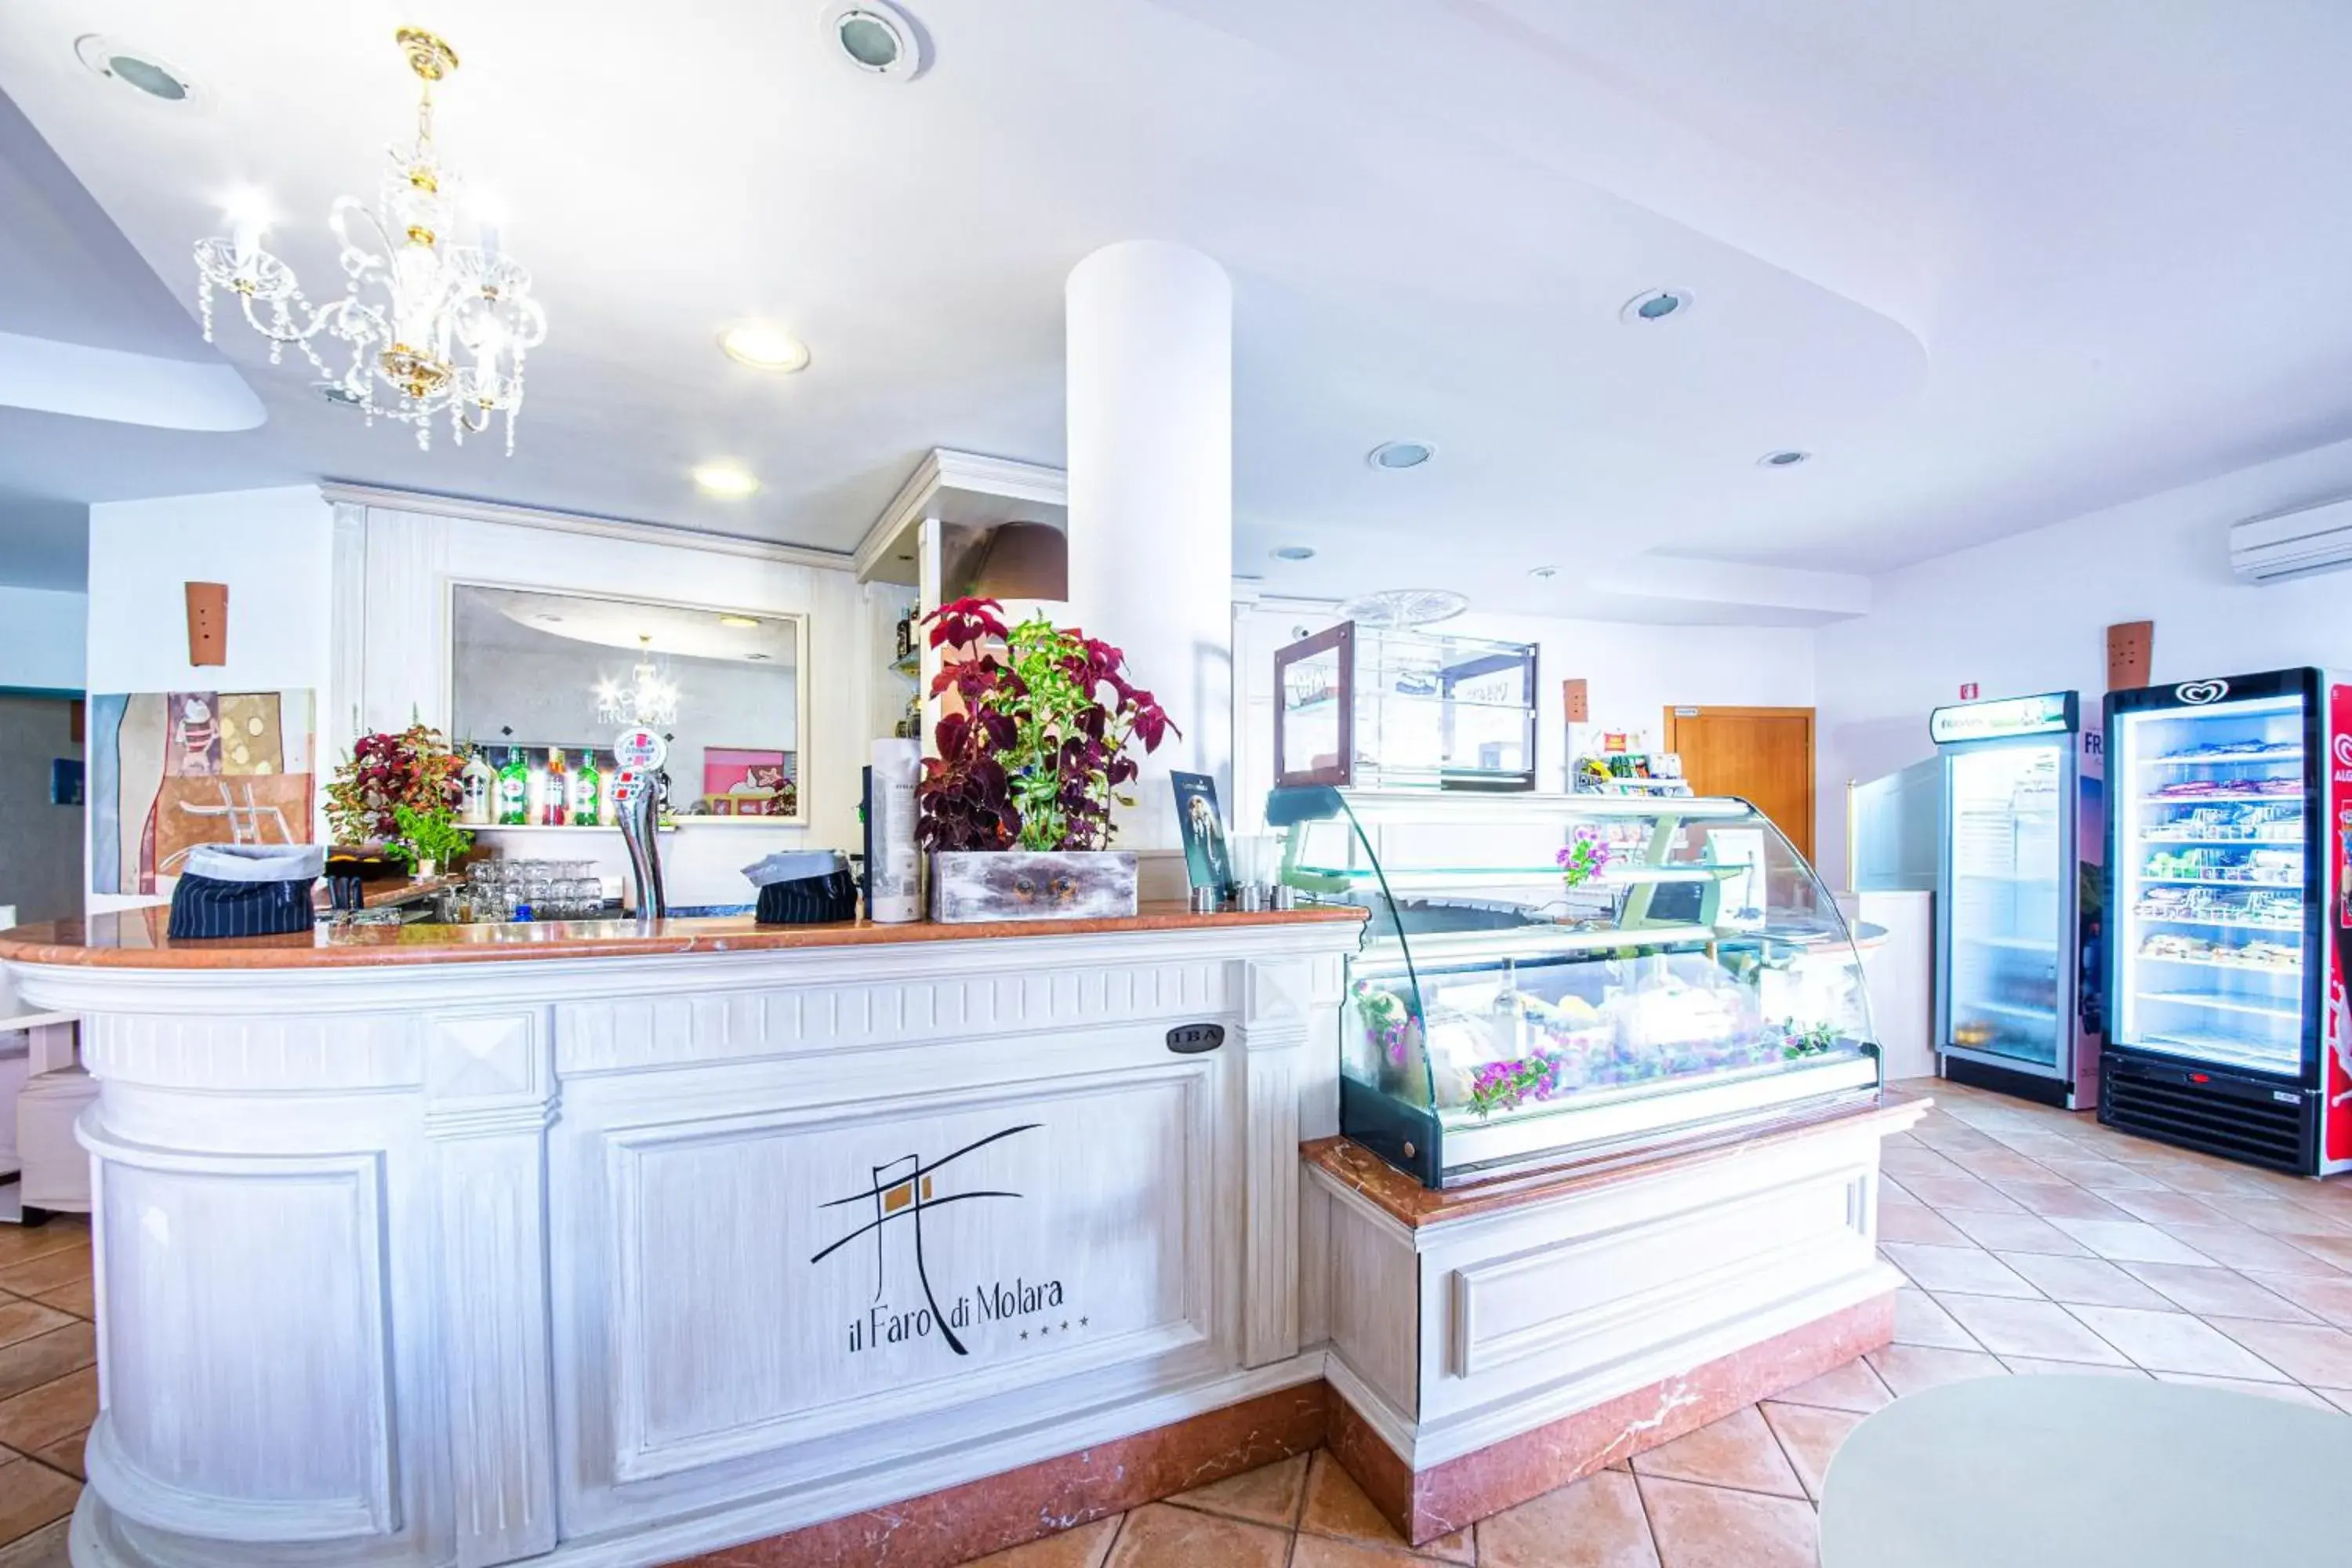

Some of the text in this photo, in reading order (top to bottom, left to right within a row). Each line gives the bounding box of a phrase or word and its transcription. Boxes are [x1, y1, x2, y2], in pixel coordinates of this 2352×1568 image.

[1174, 1029, 1217, 1044] IBA
[849, 1277, 1064, 1352] il Faro di Molara
